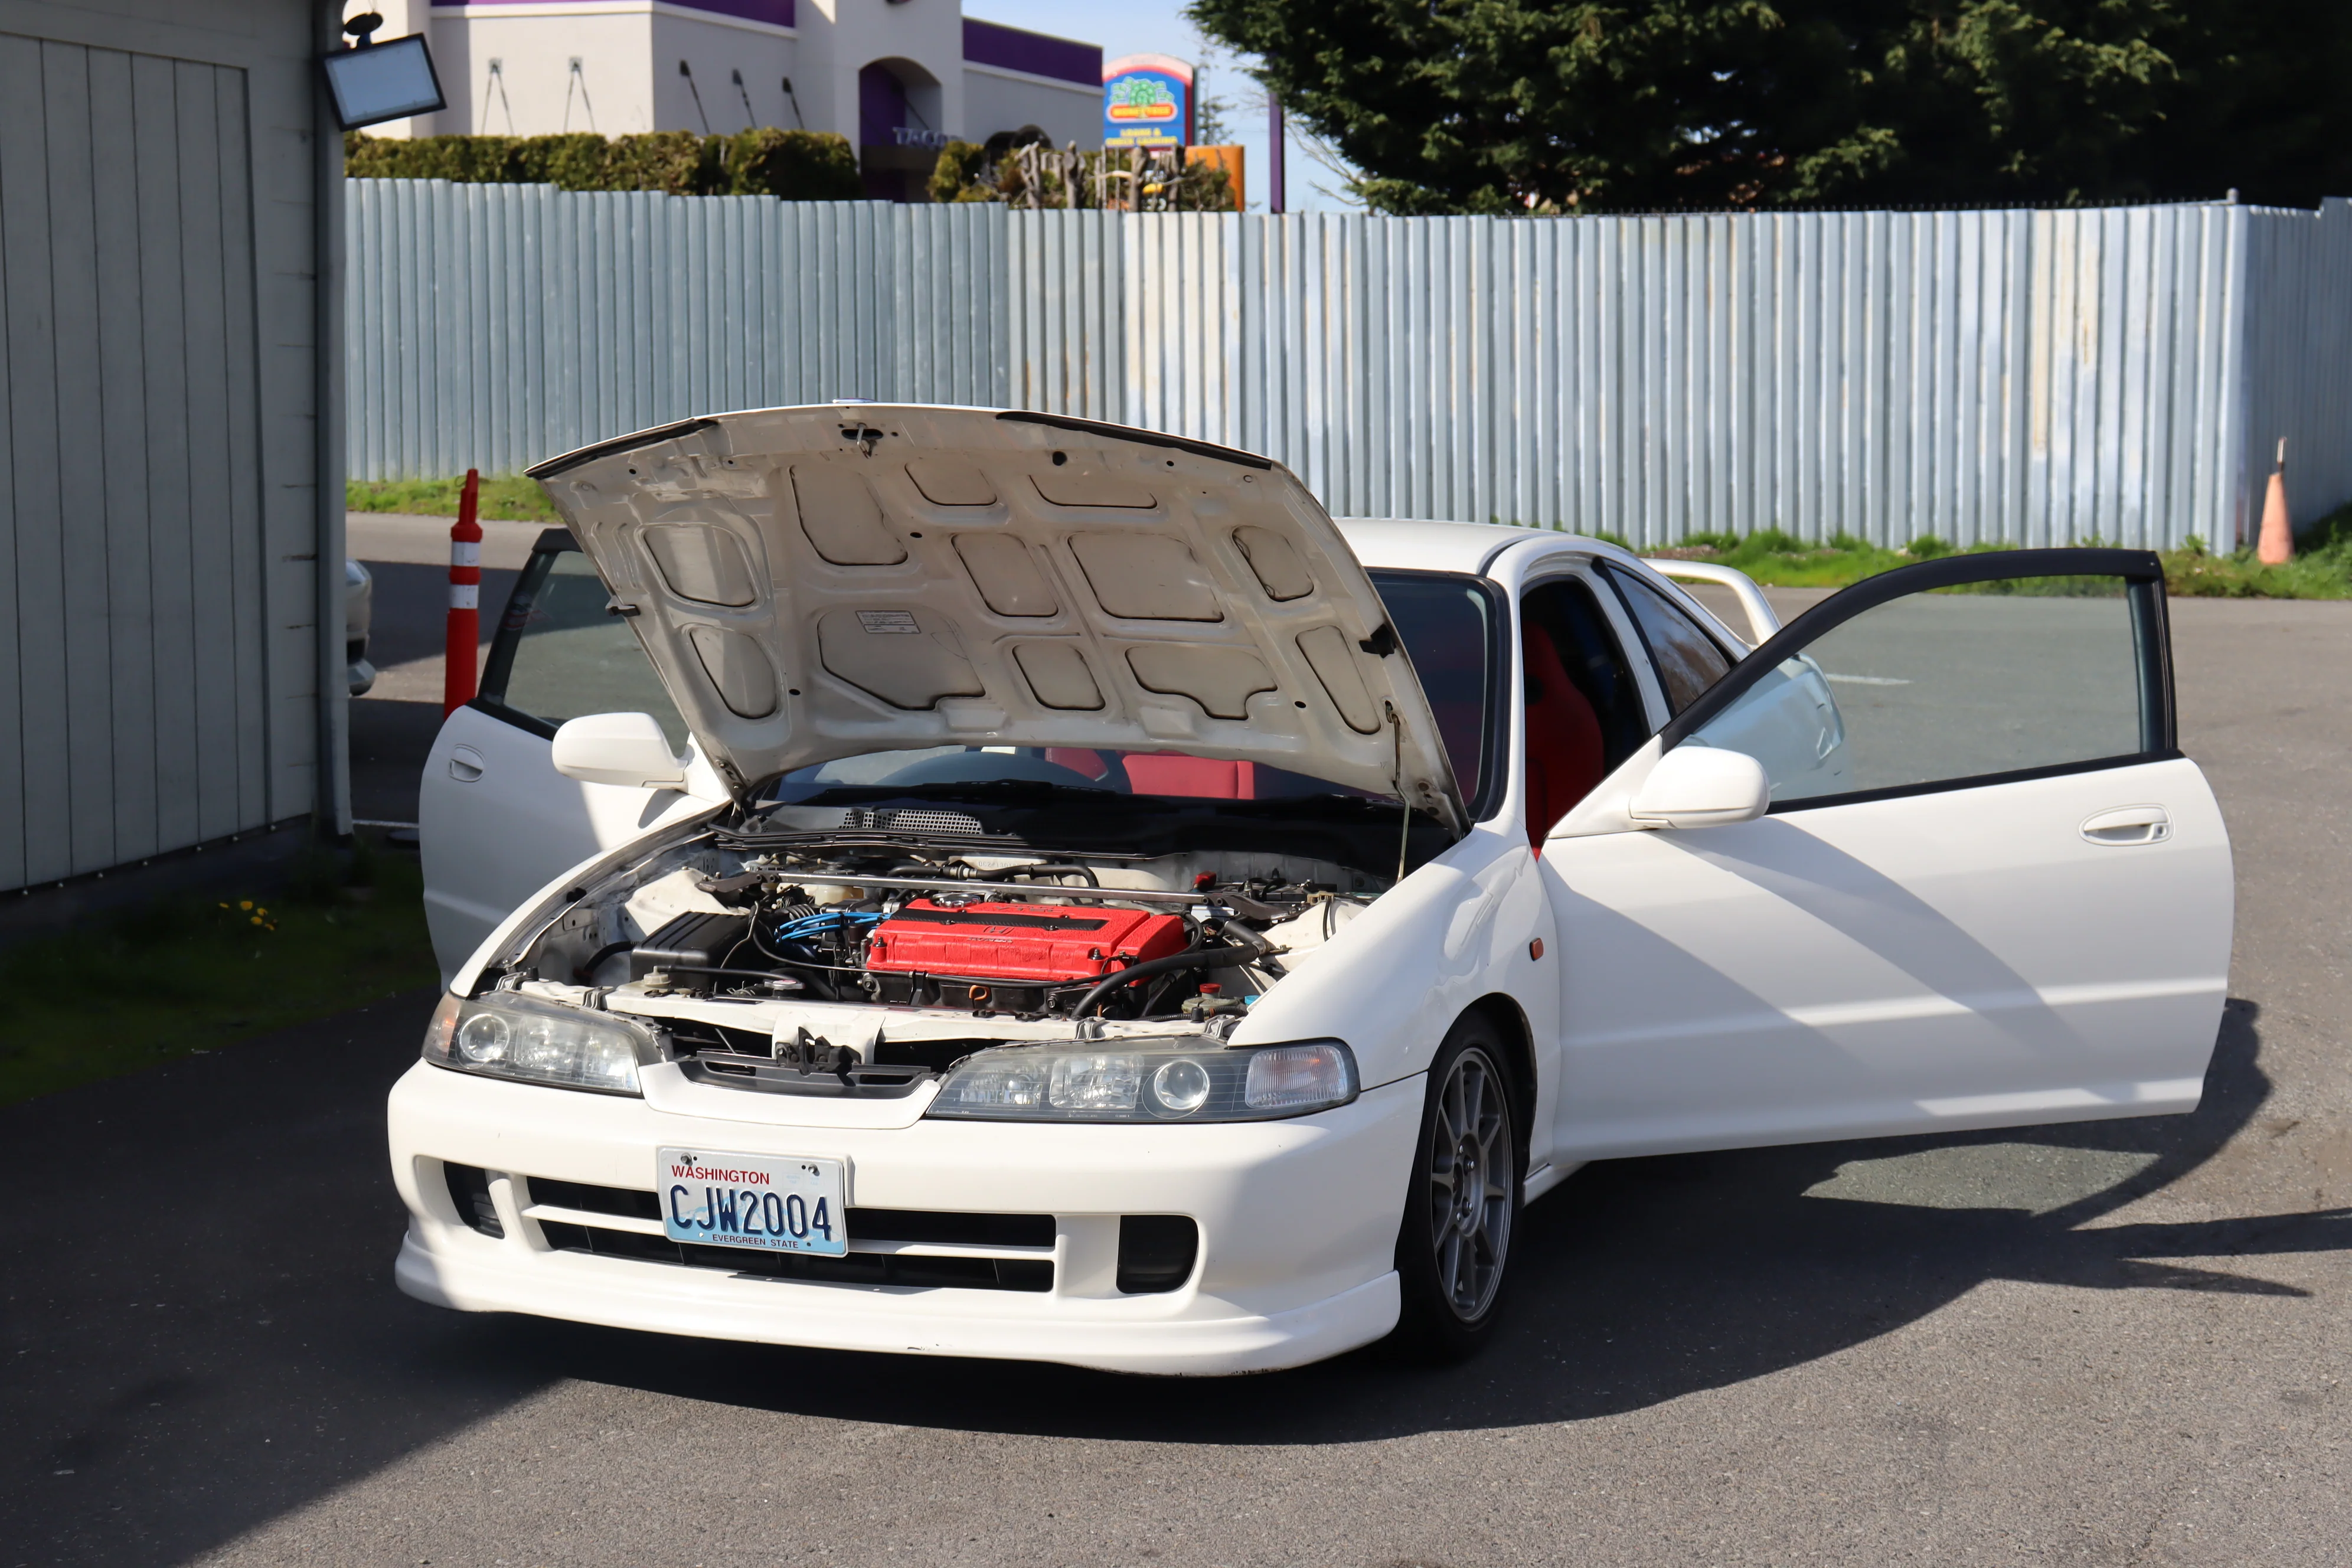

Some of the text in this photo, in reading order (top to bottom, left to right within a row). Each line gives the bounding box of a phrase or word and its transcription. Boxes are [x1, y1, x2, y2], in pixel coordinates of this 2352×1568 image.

[671, 1165, 770, 1185] WASHINGTON
[670, 1184, 831, 1241] CJW2004
[712, 1234, 799, 1249] EVERGREEN STATE
